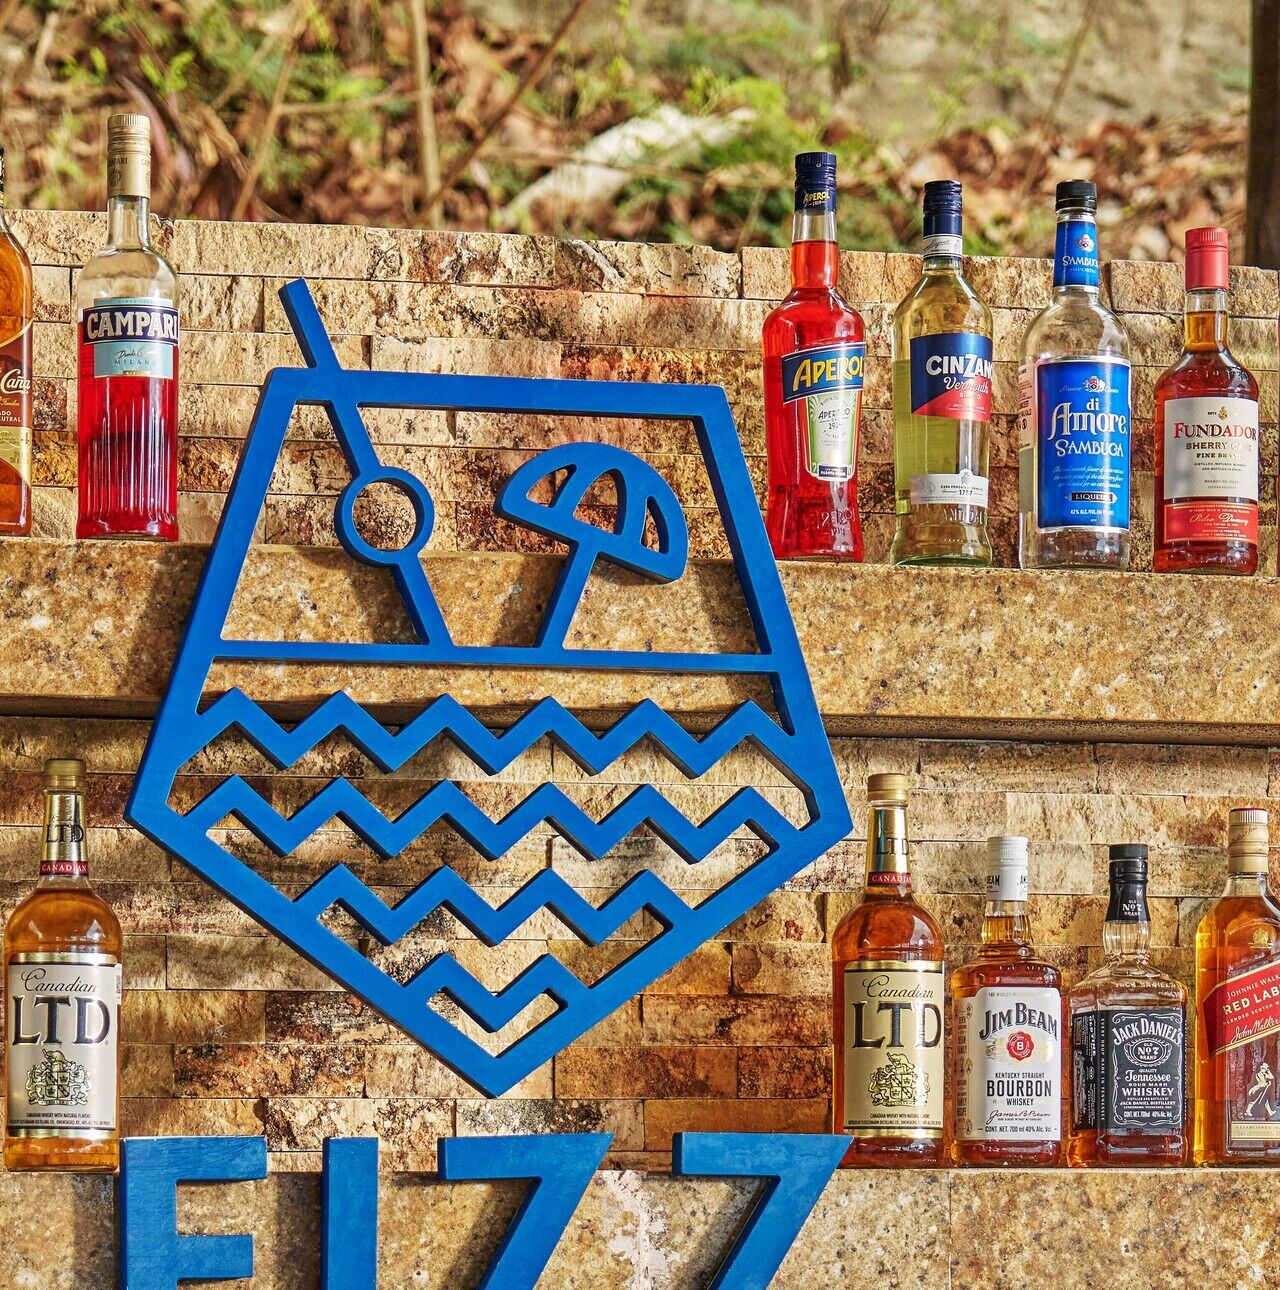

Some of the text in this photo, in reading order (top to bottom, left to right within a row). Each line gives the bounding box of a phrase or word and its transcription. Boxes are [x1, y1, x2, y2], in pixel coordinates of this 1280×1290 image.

[87, 311, 178, 339] CAMPARI
[0, 370, 30, 394] Caña
[943, 377, 989, 392] Vermouth
[1087, 399, 1099, 411] di
[1048, 402, 1126, 440] Amore
[1174, 422, 1257, 440] FUNDADOR
[1055, 439, 1124, 457] SAMBUCA
[1186, 442, 1227, 450] SHERRY
[46, 824, 84, 844] LTD
[21, 968, 96, 993] Canadian
[862, 975, 934, 998] Canadian
[1227, 984, 1259, 1001] JOHNNIE
[1223, 998, 1250, 1015] RED
[1251, 1004, 1273, 1016] SCOTCH
[12, 996, 111, 1046] LTD
[852, 1001, 941, 1049] LTD
[979, 1002, 1058, 1041] JIM BEAM
[1112, 1018, 1183, 1045] JACK DANIEL'S
[1125, 1069, 1170, 1082] Tennessee
[987, 1080, 1052, 1096] BOURBON
[1122, 1088, 1174, 1097] WHISKEY
